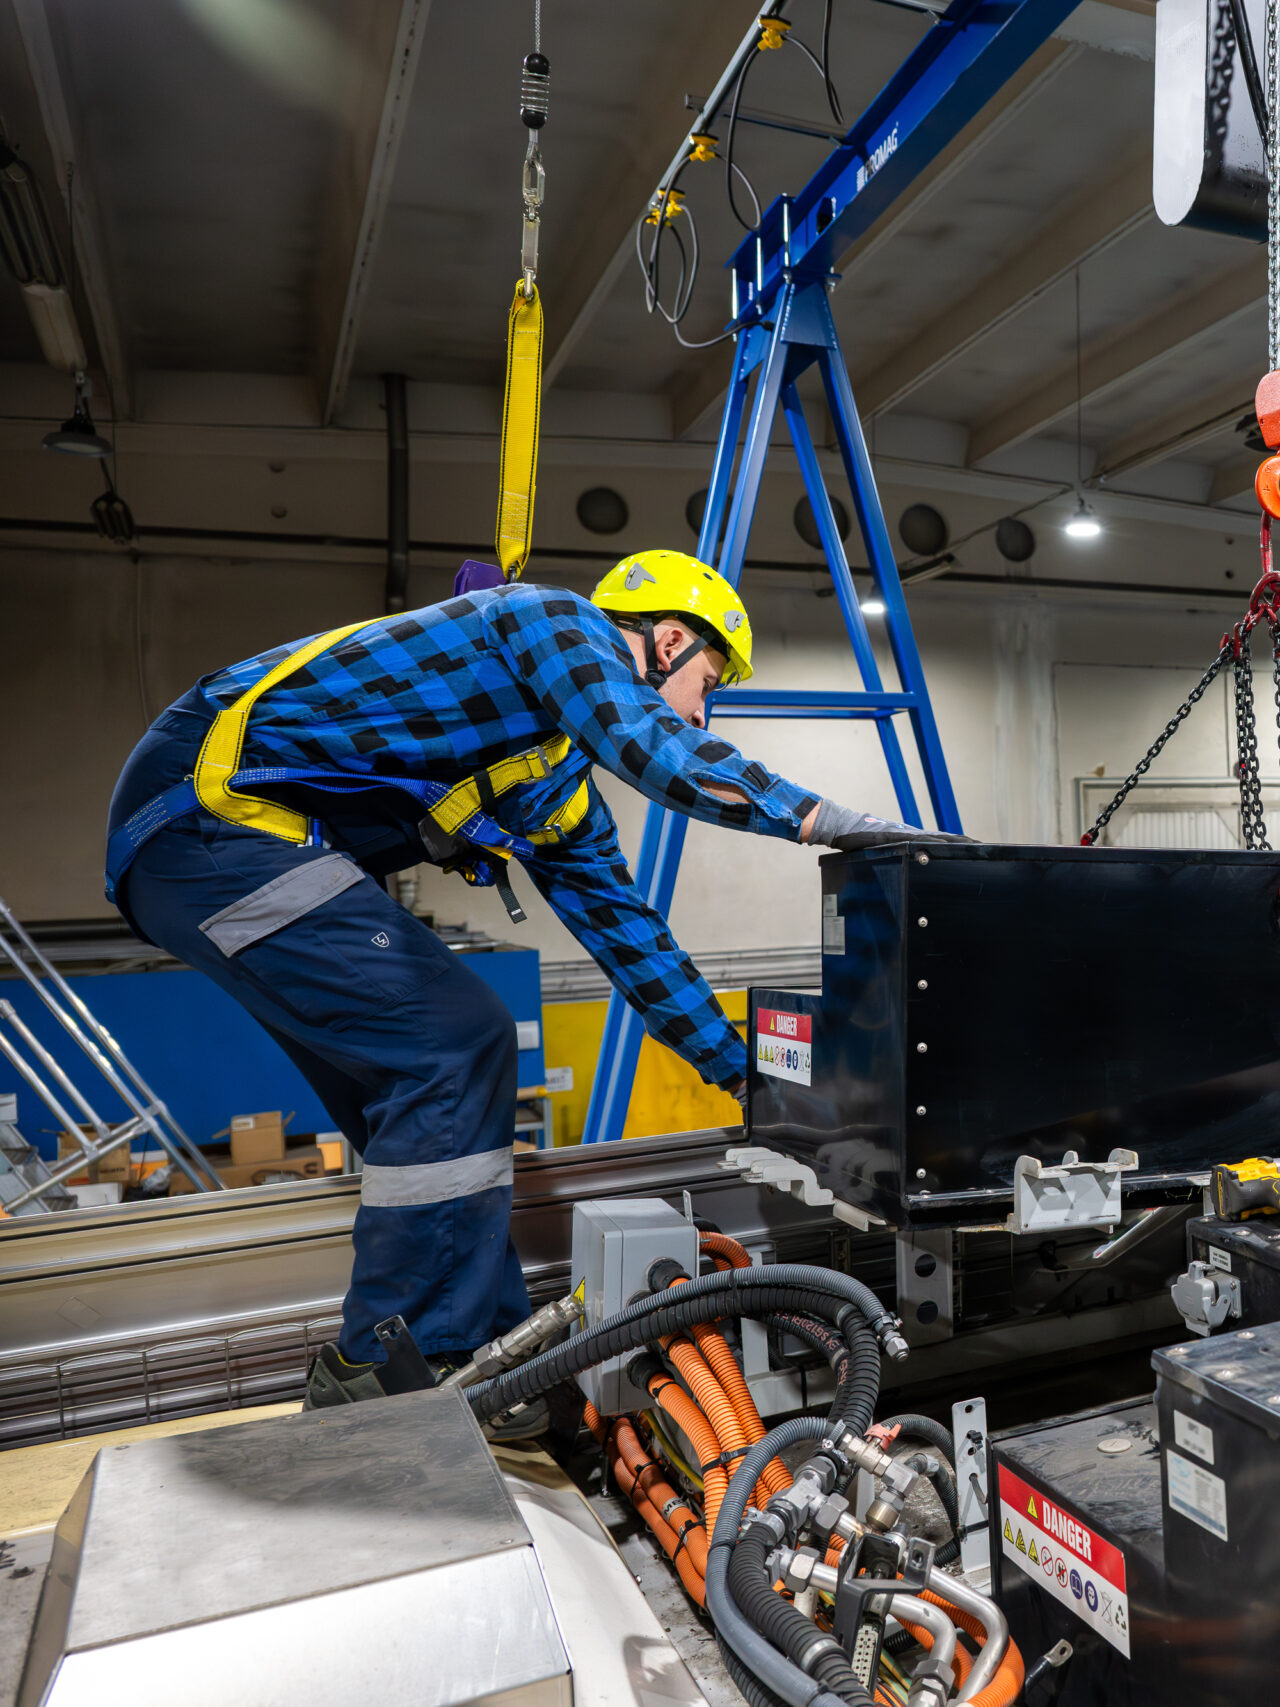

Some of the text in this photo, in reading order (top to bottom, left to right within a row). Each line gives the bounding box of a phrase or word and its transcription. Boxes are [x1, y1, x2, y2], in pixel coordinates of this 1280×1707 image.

[865, 128, 898, 183] PROMAG
[776, 1014, 798, 1036] DANGER
[1042, 1500, 1093, 1562] DANGER
